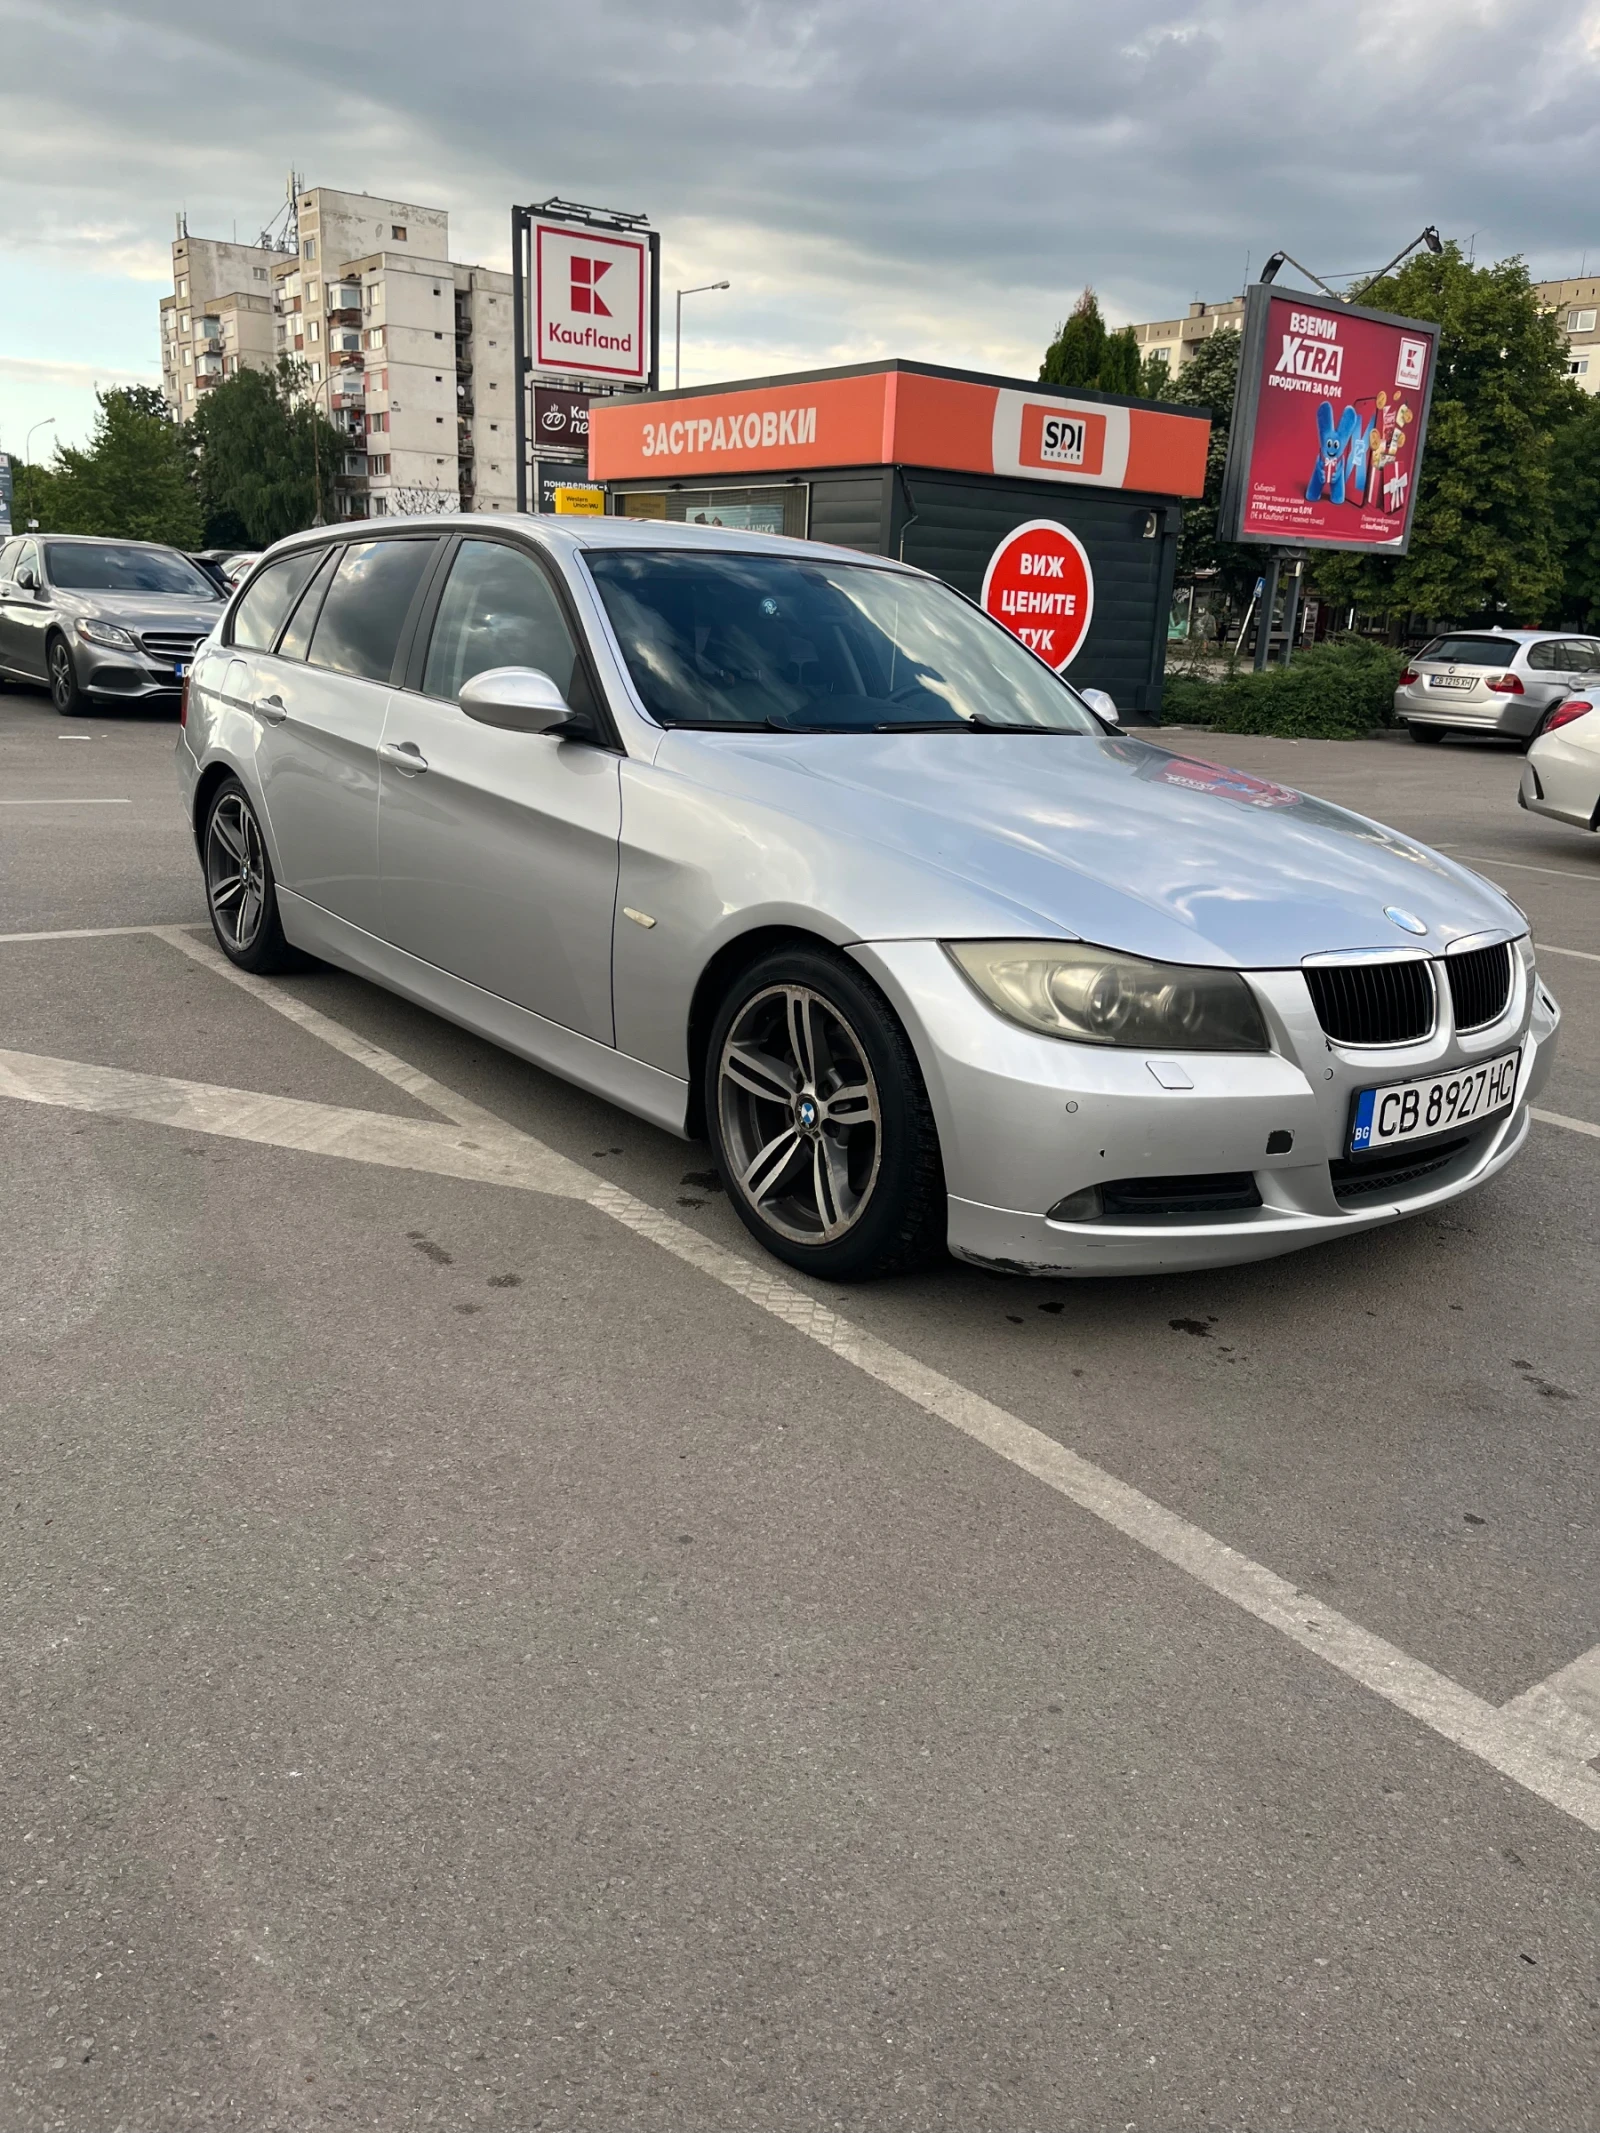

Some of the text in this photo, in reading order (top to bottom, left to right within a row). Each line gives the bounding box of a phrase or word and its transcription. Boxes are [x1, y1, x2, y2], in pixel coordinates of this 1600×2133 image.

[549, 322, 631, 352] Kaufland
[1289, 312, 1337, 341] ВЗЕМИ
[1275, 335, 1343, 382] XTRA
[1268, 374, 1342, 398] ПРОДУКТИ ЗА 0,01€
[642, 407, 816, 456] ЗАСТРАХОВКИ
[1045, 421, 1083, 452] SDI
[1044, 450, 1080, 460] BROKER
[1251, 502, 1266, 510] XTRA
[1020, 553, 1065, 578] ВИЖ
[1001, 590, 1076, 616] ЦЕНИТЕ
[1018, 628, 1055, 650] ТУК
[1378, 1059, 1514, 1137] CB 8927 HC
[1354, 1126, 1370, 1141] BG
